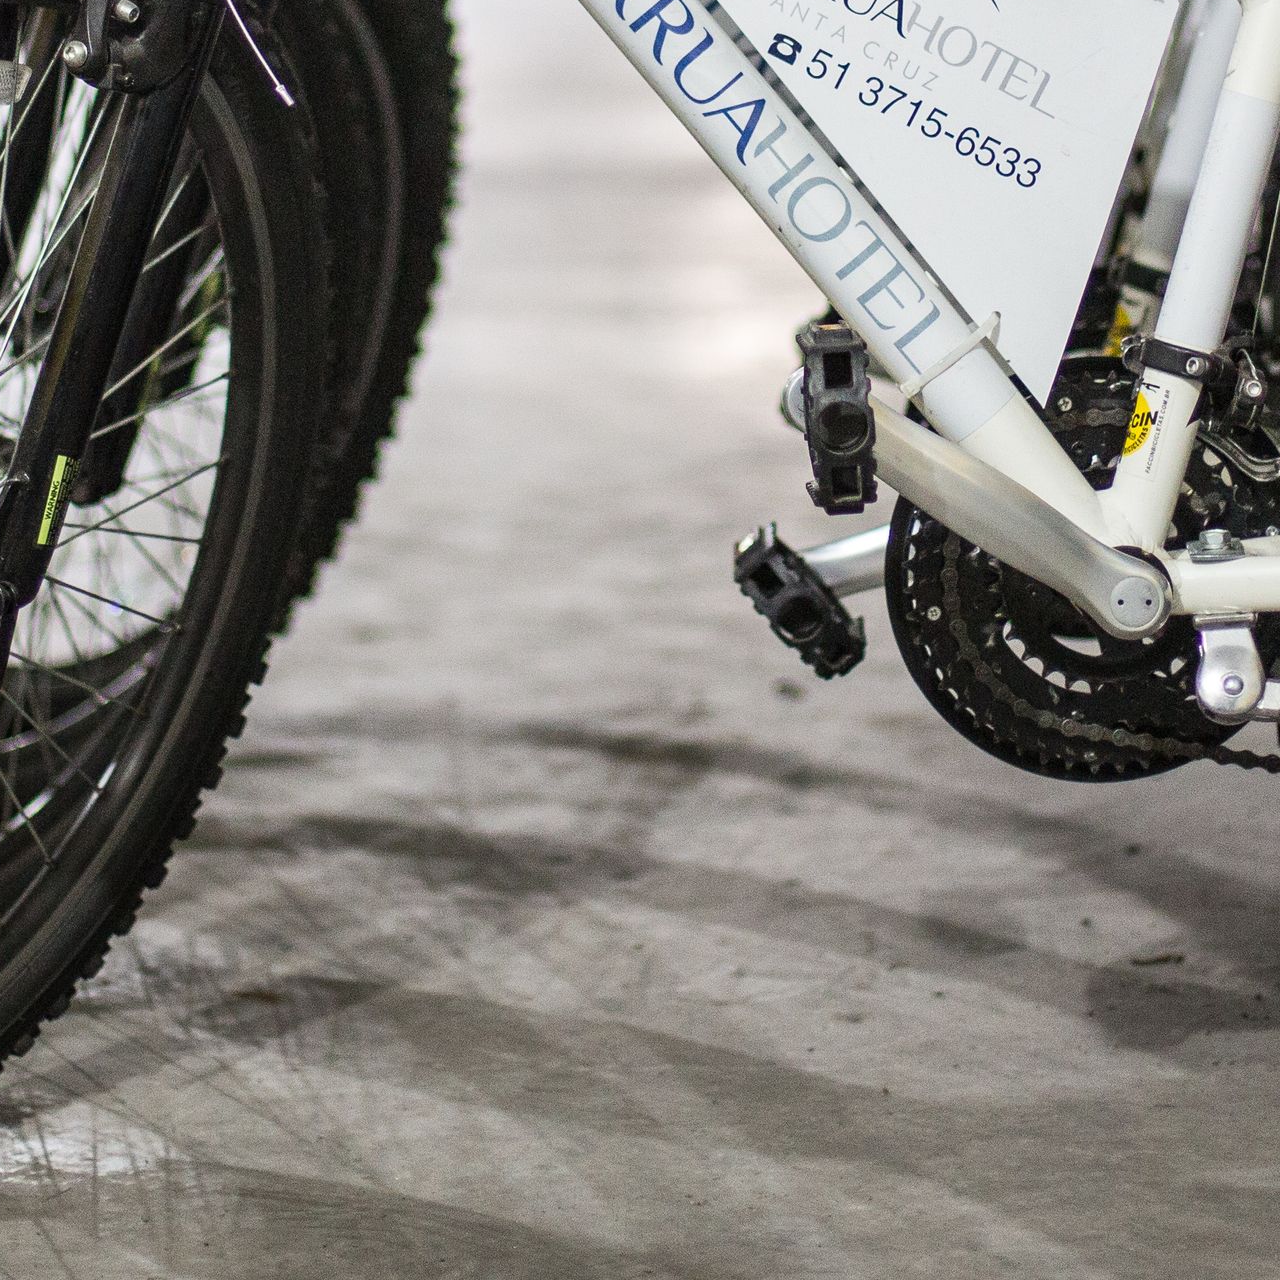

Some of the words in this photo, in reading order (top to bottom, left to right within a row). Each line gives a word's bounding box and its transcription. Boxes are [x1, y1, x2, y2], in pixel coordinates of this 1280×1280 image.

[862, 39, 940, 93] CRUZ
[805, 48, 850, 91] 51
[858, 75, 1043, 189] 3715-6533
[45, 480, 60, 520] WARNING
